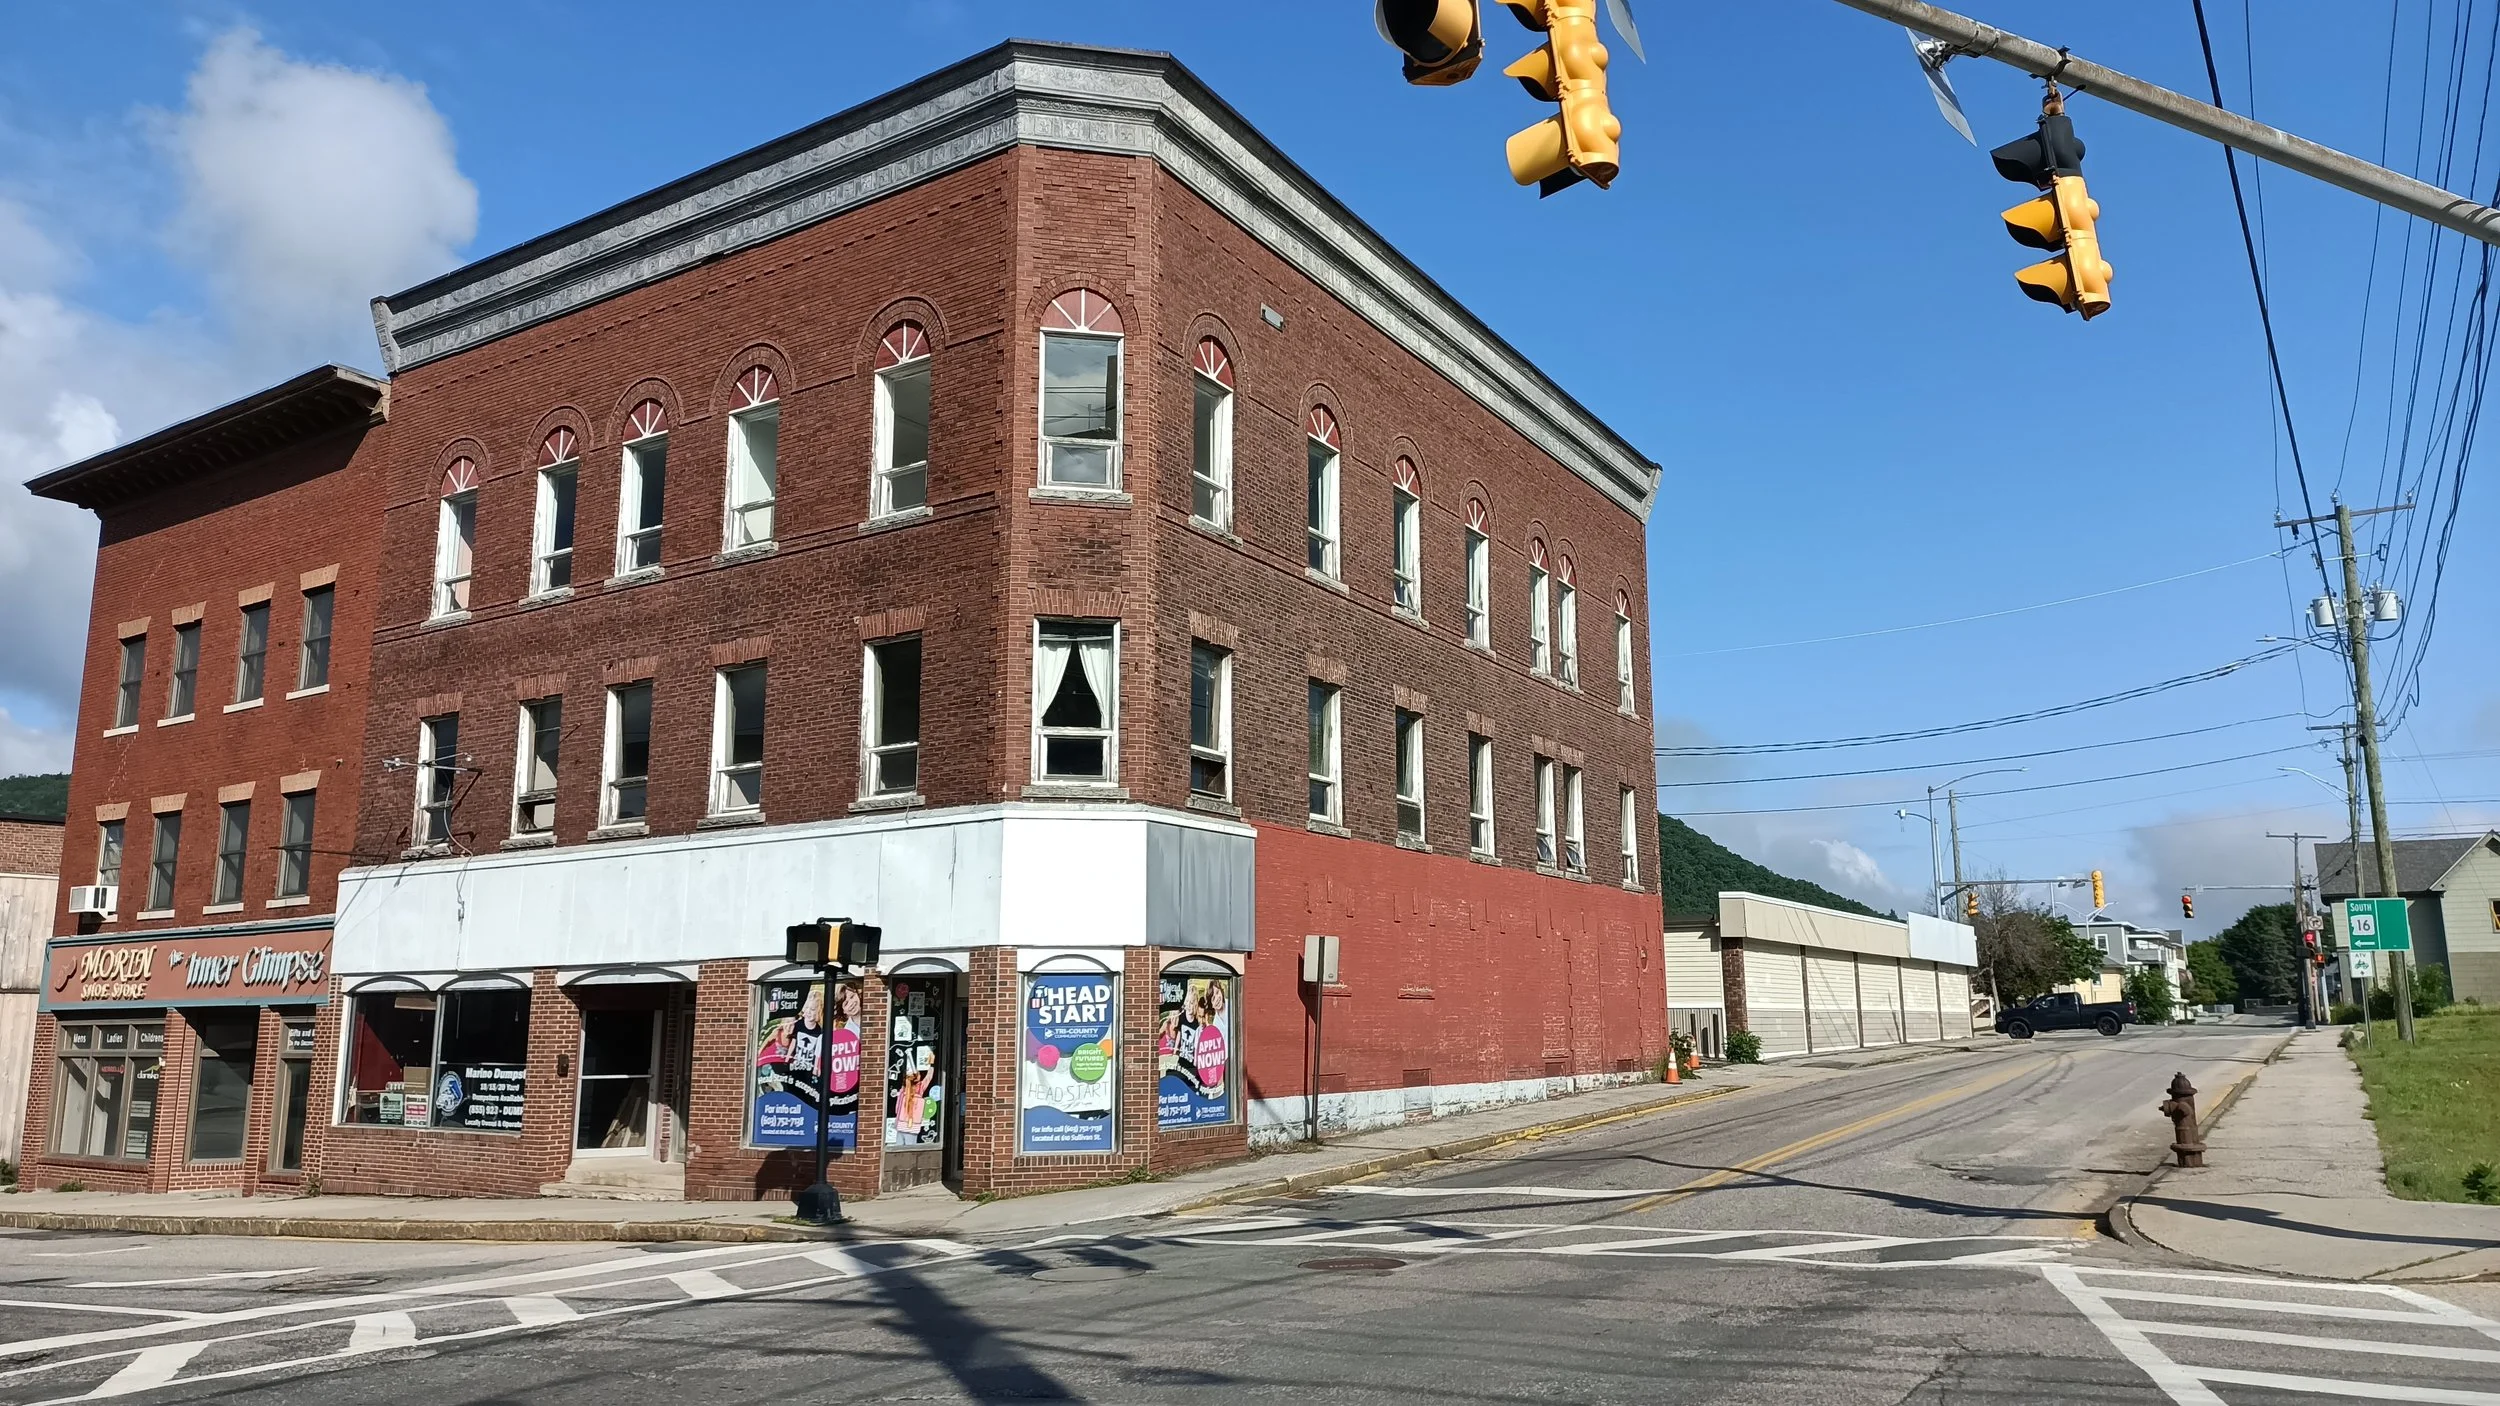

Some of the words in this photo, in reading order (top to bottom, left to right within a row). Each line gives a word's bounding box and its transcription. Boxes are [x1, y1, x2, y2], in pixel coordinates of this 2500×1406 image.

[2350, 903, 2372, 912] SOUTH
[2357, 919, 2371, 931] 16
[80, 945, 157, 982] MORIN
[185, 951, 240, 988] Inner
[241, 945, 326, 992] Glimpse
[81, 983, 111, 1000] SHOE
[111, 981, 148, 999] STORE
[781, 990, 799, 1000] Head
[1047, 985, 1111, 1006] HEAD
[780, 1001, 798, 1010] Start
[1038, 1004, 1108, 1025] START
[73, 1033, 87, 1043] Mens
[106, 1033, 123, 1043] Ladies
[140, 1033, 164, 1043] Childrens
[832, 1040, 858, 1057] PPLY
[1198, 1037, 1223, 1054] APPLY
[832, 1056, 860, 1073] OW!
[1197, 1051, 1225, 1071] NOW!
[466, 1068, 493, 1078] Marino
[794, 1080, 821, 1103] accepting
[1028, 1082, 1064, 1102] HEAD
[1066, 1081, 1109, 1102] START
[486, 1105, 499, 1116] 923
[764, 1104, 777, 1114] For
[776, 1104, 789, 1114] info
[790, 1104, 802, 1114] call
[760, 1115, 777, 1126] (603)
[1041, 1125, 1053, 1133] info
[1064, 1125, 1079, 1134] (603)
[1031, 1134, 1054, 1142] Located
